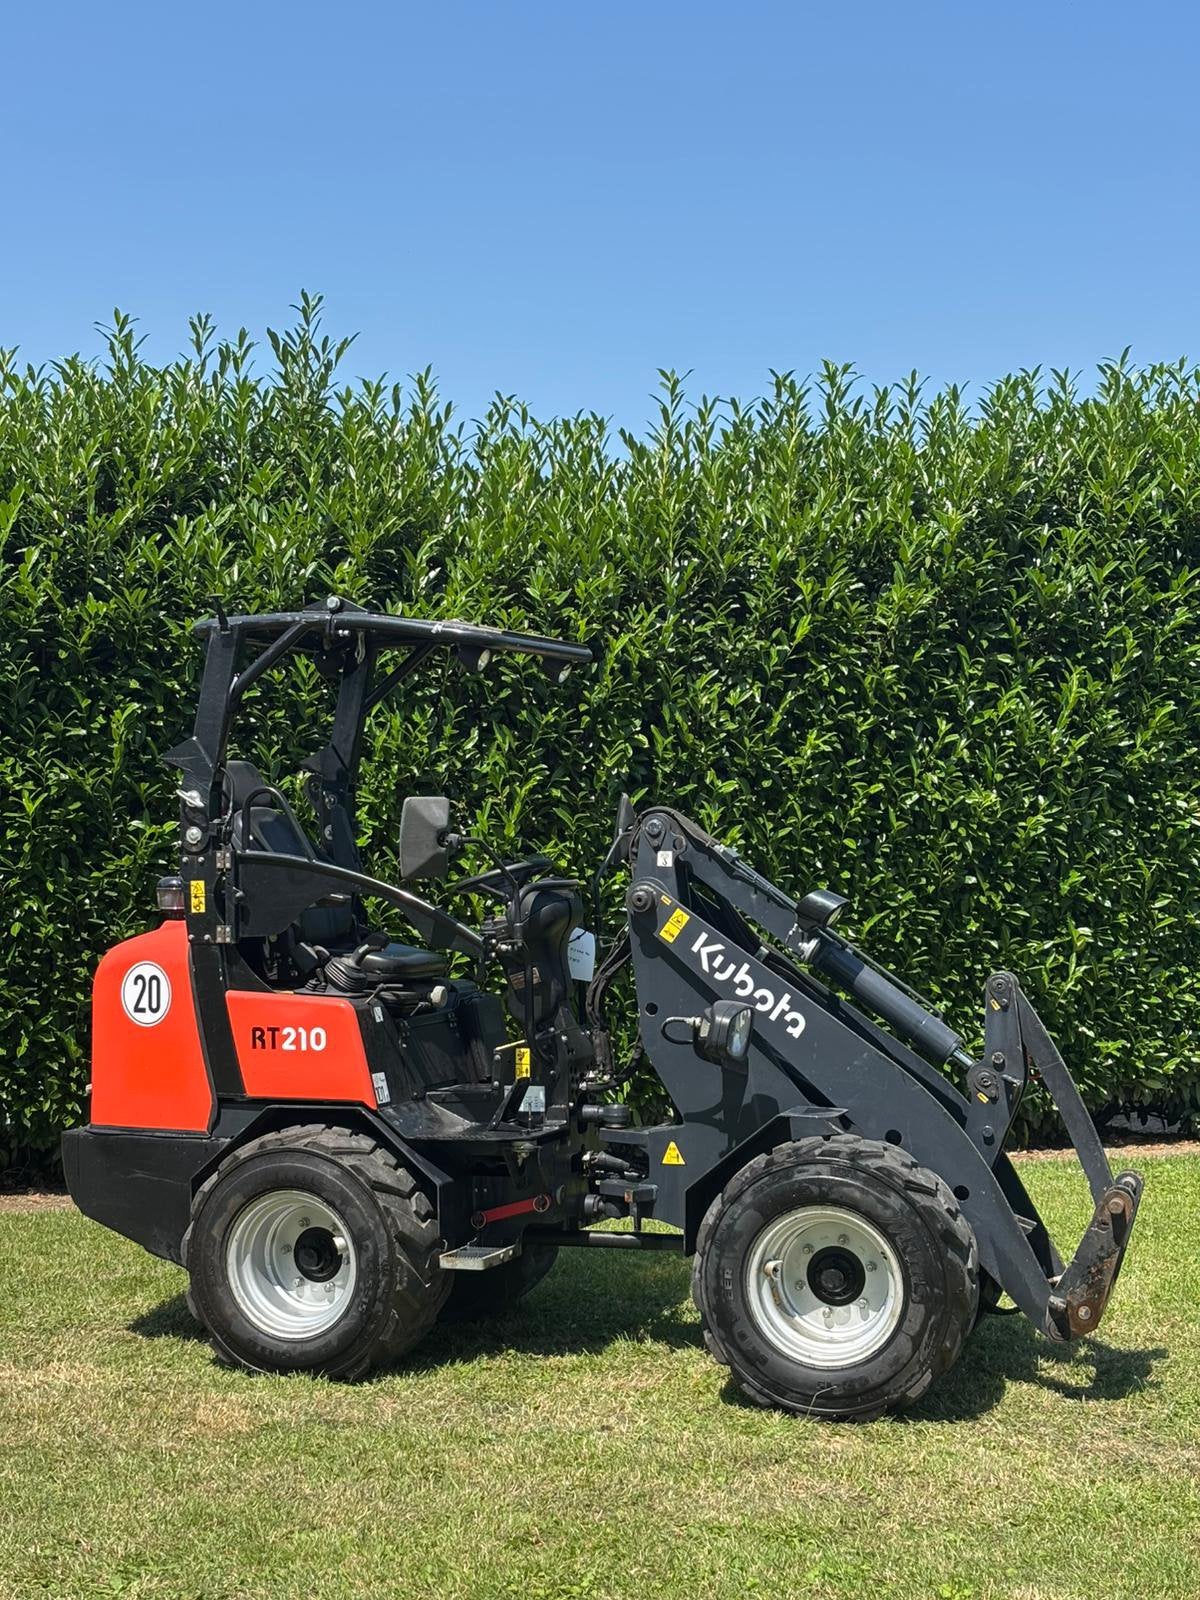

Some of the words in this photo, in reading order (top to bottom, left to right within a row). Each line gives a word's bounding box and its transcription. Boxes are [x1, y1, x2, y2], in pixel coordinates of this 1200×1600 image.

[133, 974, 161, 1014] 20
[691, 931, 806, 1039] Kubota
[251, 1026, 327, 1052] RT210
